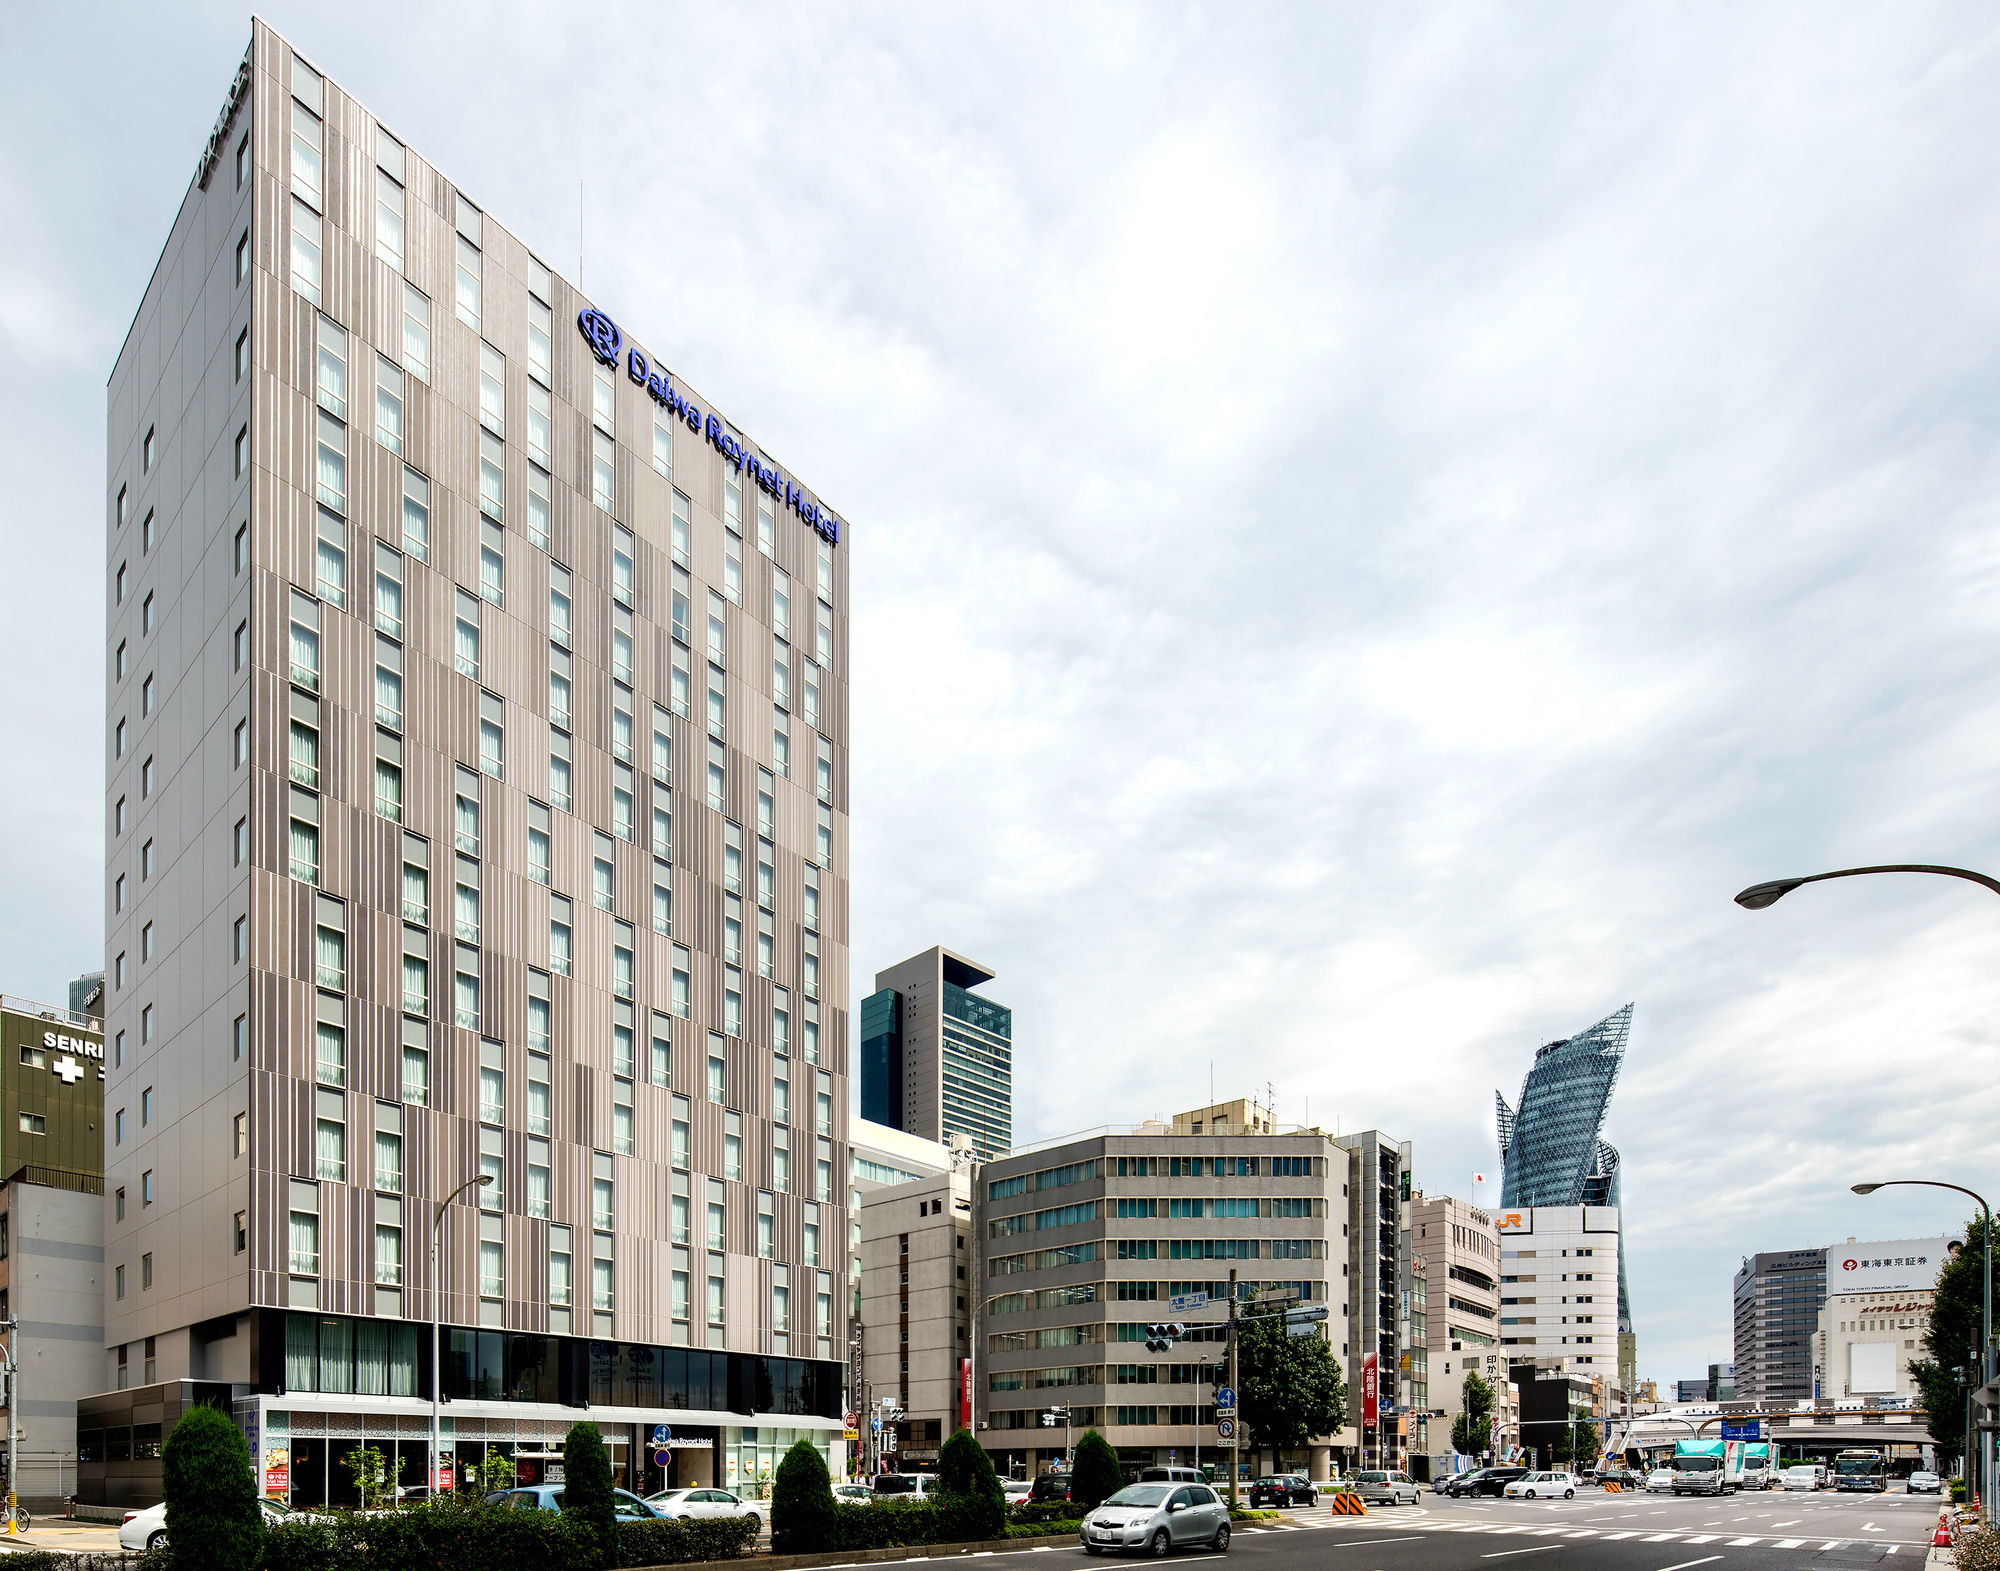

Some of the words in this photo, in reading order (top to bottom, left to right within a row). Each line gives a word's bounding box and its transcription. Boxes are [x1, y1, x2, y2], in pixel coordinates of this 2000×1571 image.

[629, 347, 702, 430] Daiwa
[707, 413, 785, 498] Roynet
[788, 480, 840, 544] Hotel
[43, 1031, 104, 1059] SENRI
[1497, 1213, 1522, 1228] JR
[1861, 1256, 1928, 1269] 東海東京証券
[1366, 1367, 1375, 1399] 北陸銀行
